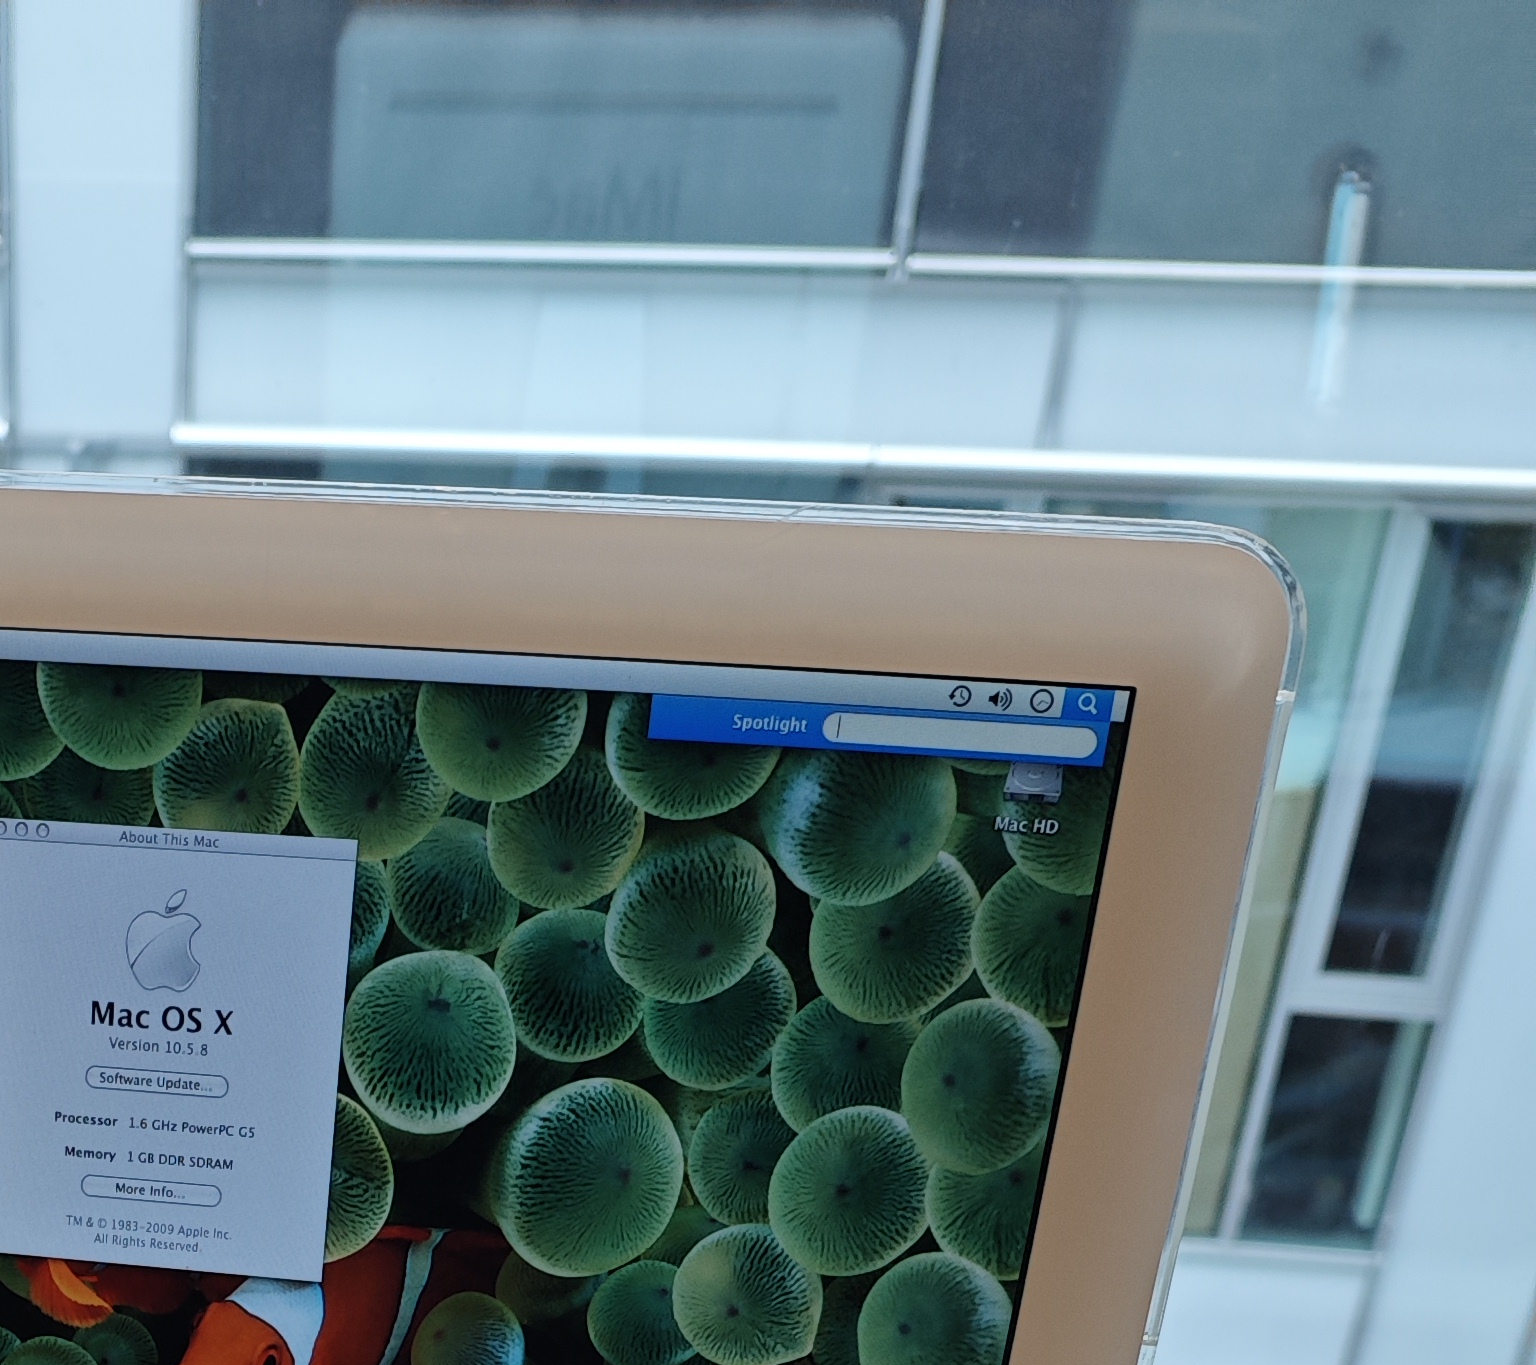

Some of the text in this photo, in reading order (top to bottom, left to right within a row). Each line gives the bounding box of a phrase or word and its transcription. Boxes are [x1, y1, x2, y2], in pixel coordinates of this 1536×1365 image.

[732, 713, 808, 734] Spotlight
[994, 815, 1059, 835] Mac HD
[118, 830, 220, 849] About This Mac
[90, 1000, 234, 1036] Mac OS X
[109, 1036, 209, 1058] Version 10.5.8
[99, 1071, 152, 1089] Software
[54, 1110, 256, 1139] Processor 1.6 GHz PowerPC G5
[64, 1145, 234, 1171] Memory 1 GB DDR SDRAM
[115, 1181, 146, 1197] More
[65, 1214, 83, 1227] TM
[111, 1218, 175, 1235] 1983-2009
[176, 1224, 210, 1239] Apple
[213, 1227, 232, 1241] Inc.
[93, 1232, 202, 1253] All Rights Reserved.
